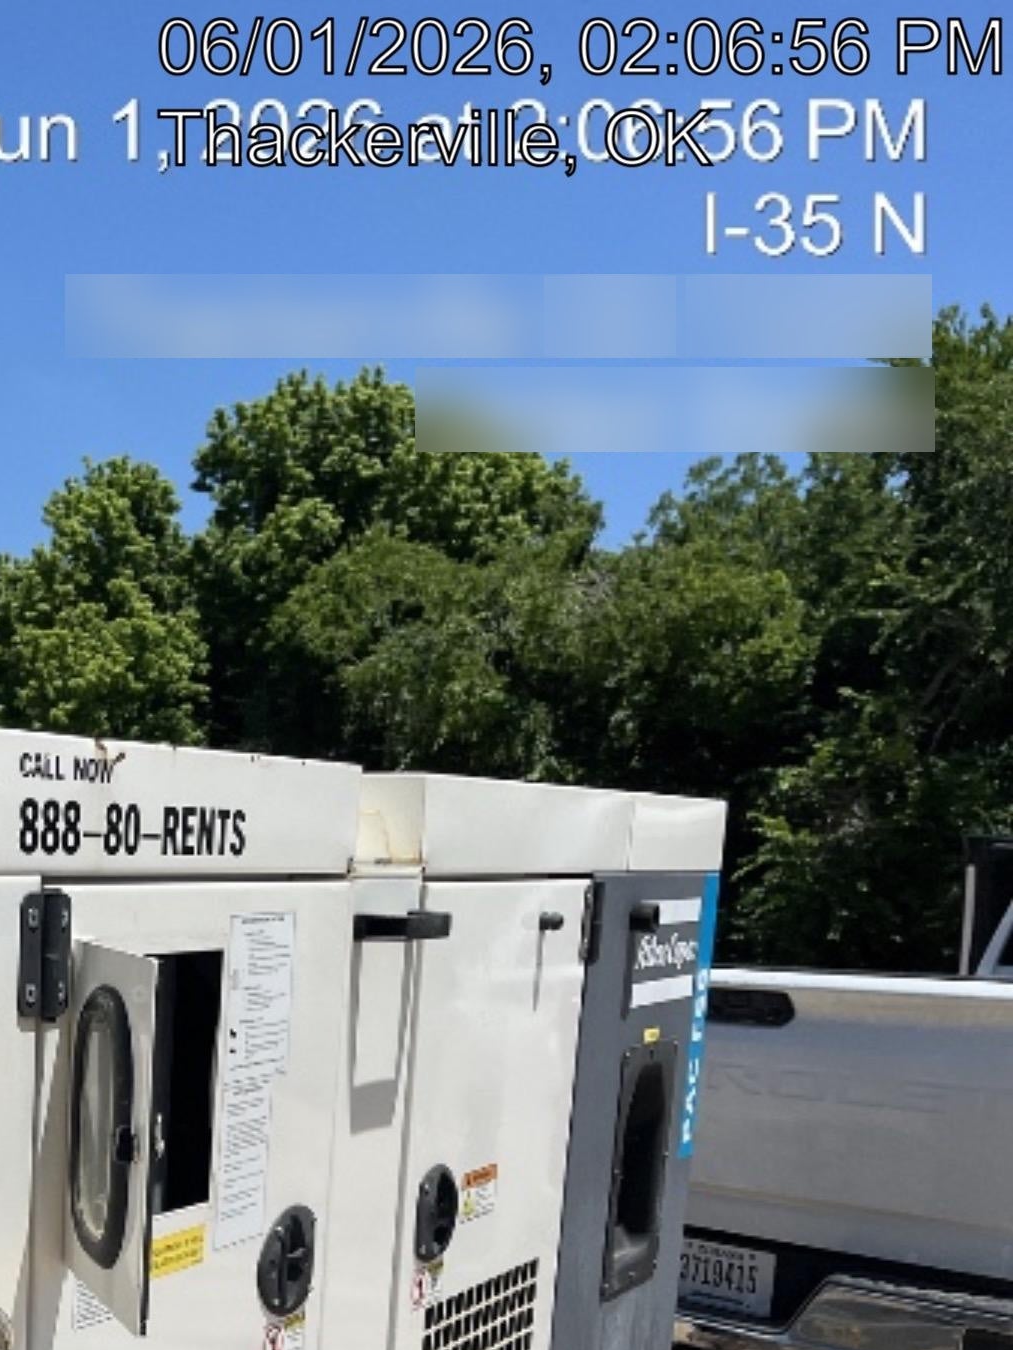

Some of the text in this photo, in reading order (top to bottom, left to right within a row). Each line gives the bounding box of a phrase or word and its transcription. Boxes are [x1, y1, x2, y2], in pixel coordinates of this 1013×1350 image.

[19, 753, 114, 784] CALL NOW
[19, 797, 247, 856] 888-80-RENTS
